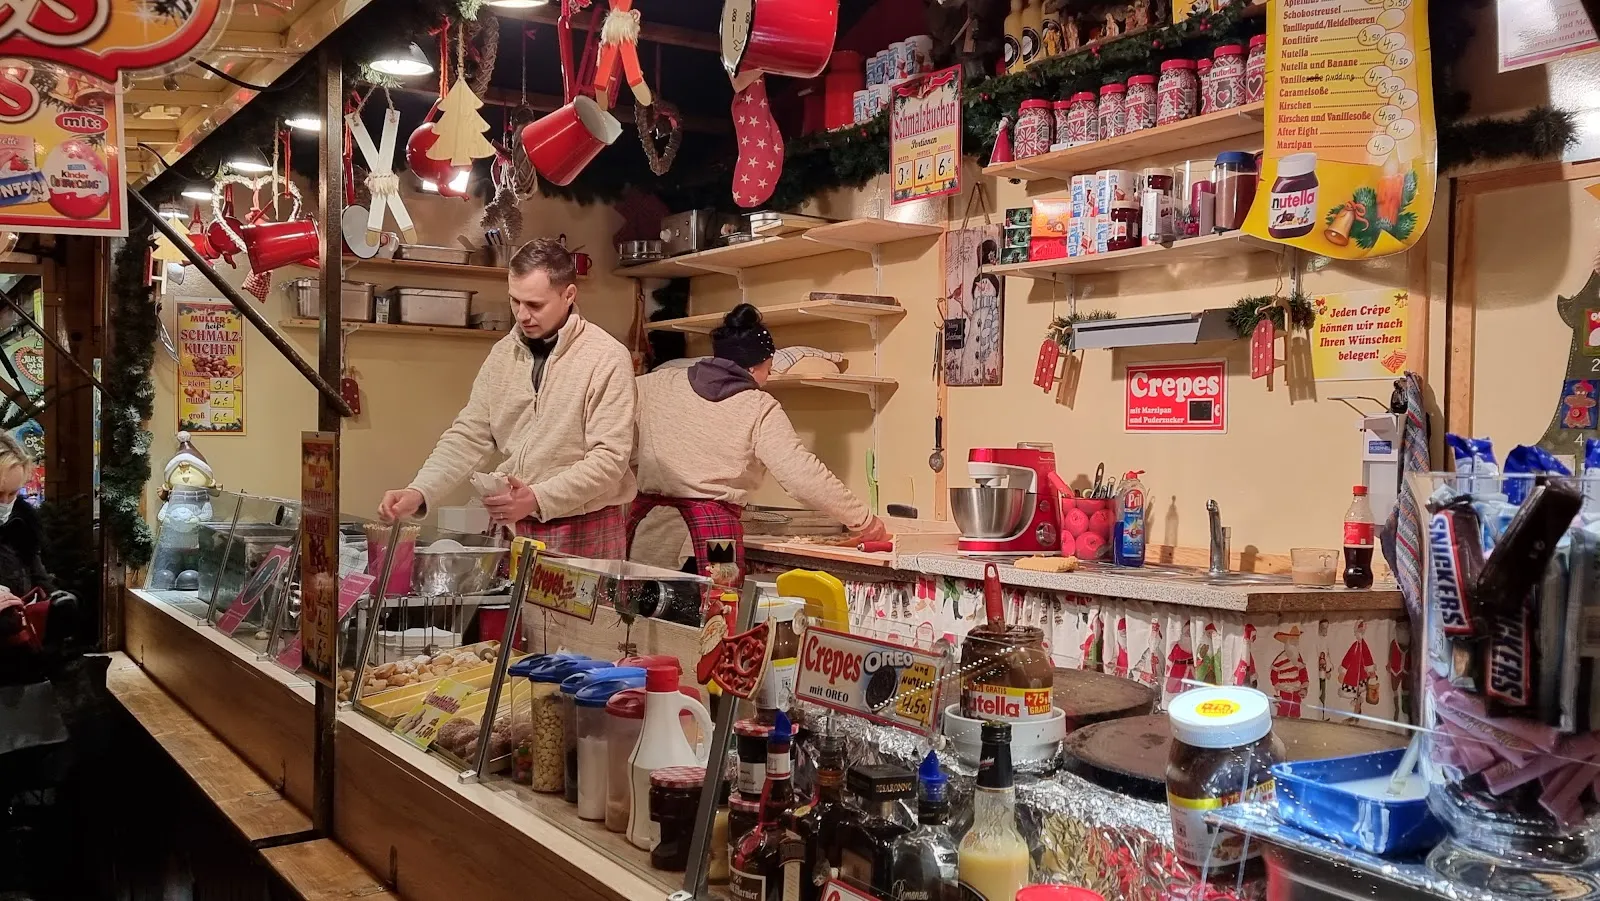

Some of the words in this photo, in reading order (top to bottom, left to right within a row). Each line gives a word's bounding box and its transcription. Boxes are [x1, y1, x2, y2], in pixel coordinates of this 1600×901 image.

[1283, 5, 1341, 19] Schokostreusel
[1281, 34, 1319, 46] Konfitüre
[1281, 48, 1309, 59] Nutella
[1280, 61, 1308, 72] Nutella
[1309, 59, 1326, 69] und
[1327, 57, 1358, 67] Banane
[1279, 87, 1329, 98] Caramelsoße
[1278, 101, 1312, 110] Kirschen
[1278, 113, 1309, 124] Kirschen
[1310, 113, 1326, 122] und
[1326, 110, 1372, 122] Vanillesoße
[1277, 127, 1297, 136] After
[1297, 126, 1319, 137] Eight
[0, 137, 19, 147] ette
[1276, 140, 1313, 150] Marzipan
[0, 181, 32, 199] NTY
[1272, 189, 1315, 209] nutella
[1329, 307, 1357, 319] Jeden
[1359, 304, 1391, 317] Crêpe
[204, 322, 226, 332] heiße
[1319, 323, 1353, 333] können
[1356, 320, 1374, 331] wir
[1376, 318, 1403, 329] nach
[1319, 337, 1345, 347] Ihren
[1348, 333, 1402, 345] Wünschen
[184, 342, 236, 355] KUCHEN
[1338, 348, 1380, 362] belegen!
[1130, 371, 1220, 403] Crepes
[187, 411, 206, 422] groß
[1141, 406, 1172, 416] Marzipan
[1143, 416, 1185, 425] Puderzucker
[1573, 432, 1585, 447] 4
[1128, 493, 1142, 508] Pril
[1429, 517, 1467, 628] SNICKERS
[804, 635, 863, 686] Crepes
[863, 650, 914, 675] OREO
[914, 666, 929, 676] und
[809, 685, 823, 695] mit
[825, 688, 850, 704] OREO
[985, 686, 1007, 695] GRATIS
[970, 695, 1020, 718] utella
